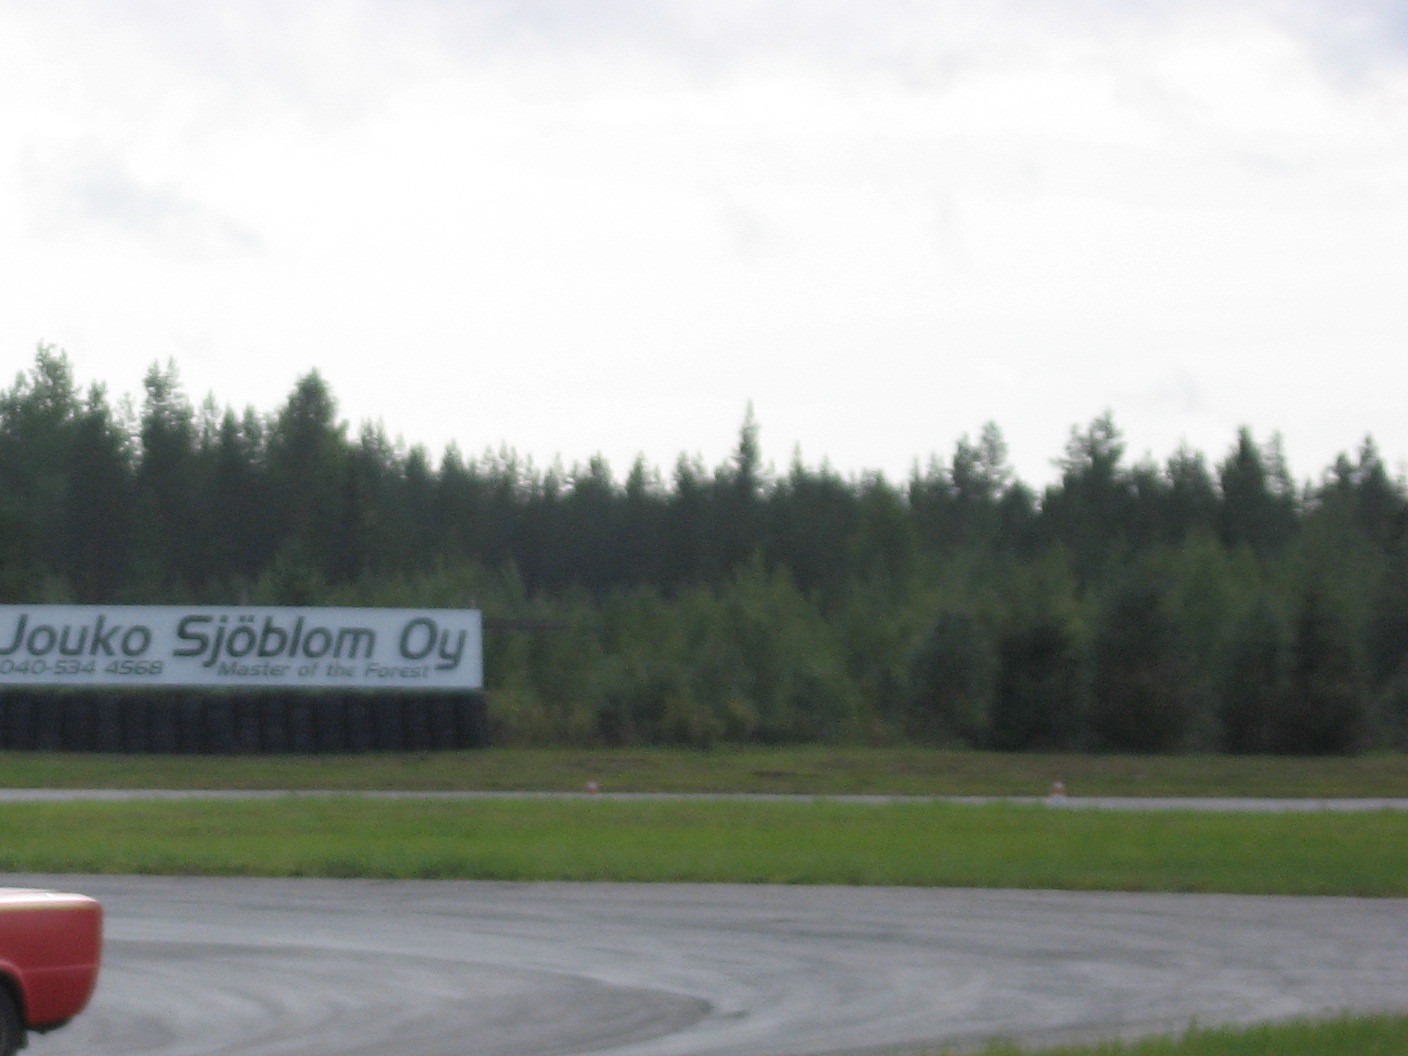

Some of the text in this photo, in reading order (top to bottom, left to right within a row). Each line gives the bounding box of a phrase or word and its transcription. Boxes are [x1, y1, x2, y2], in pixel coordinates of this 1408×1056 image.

[173, 614, 377, 668] Sjöblom
[399, 616, 468, 670] Oy
[218, 661, 288, 677] Master
[298, 661, 318, 677] of
[365, 662, 429, 678] Forest
